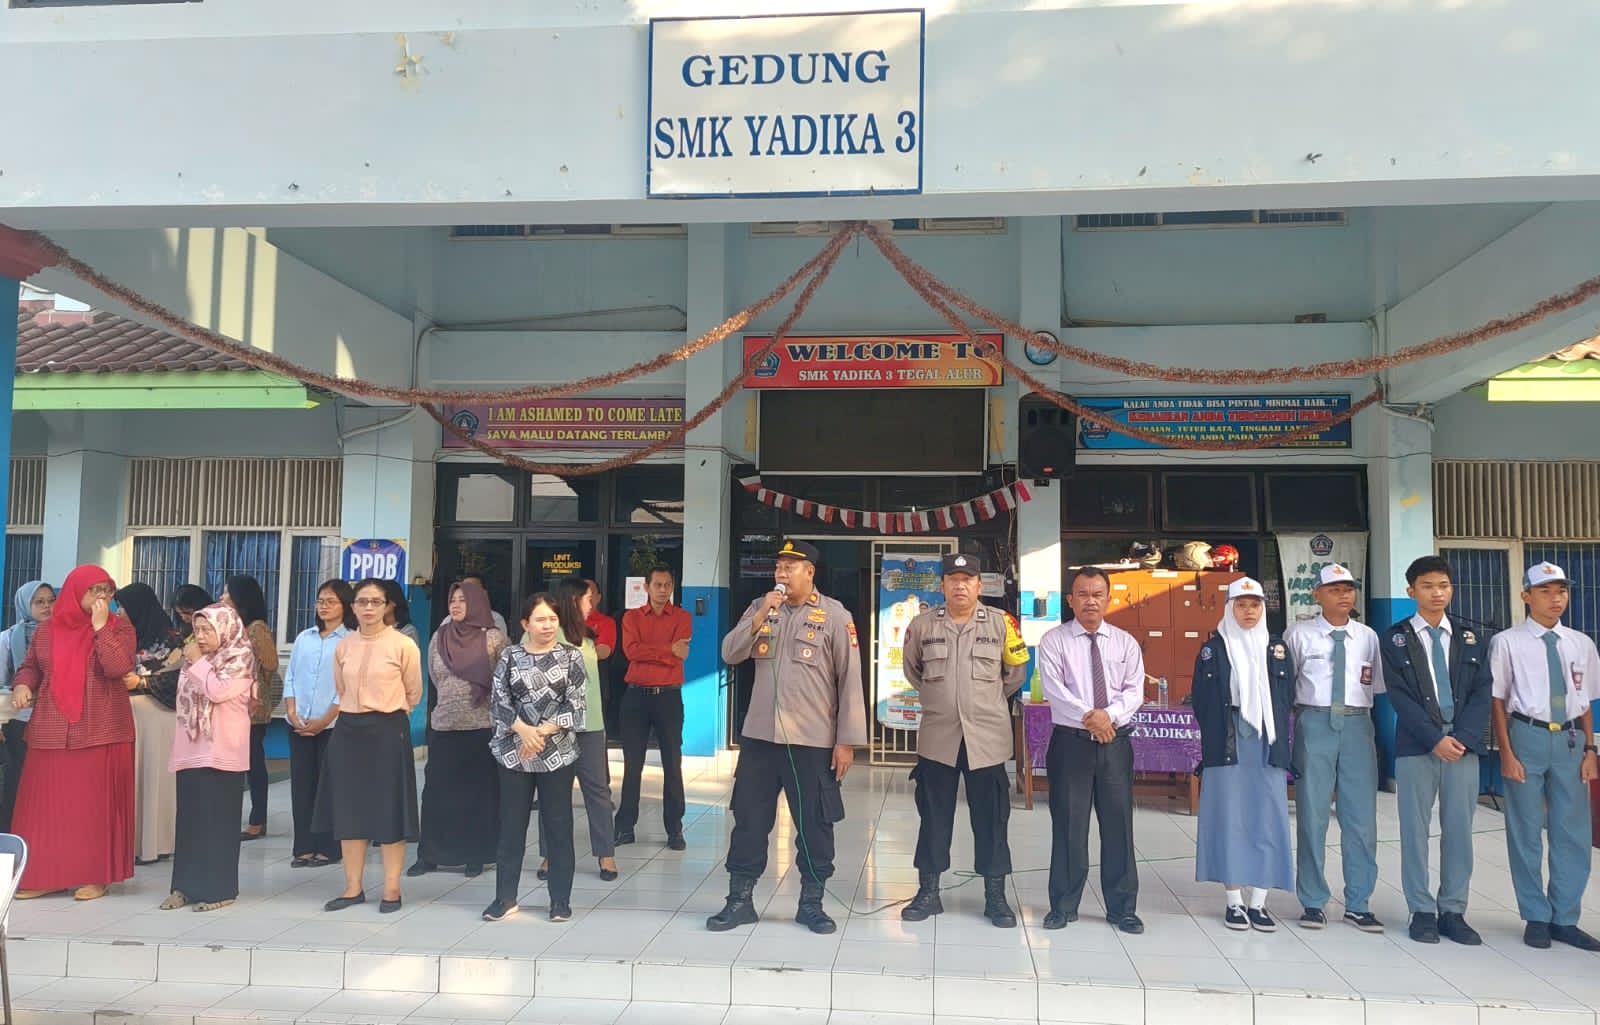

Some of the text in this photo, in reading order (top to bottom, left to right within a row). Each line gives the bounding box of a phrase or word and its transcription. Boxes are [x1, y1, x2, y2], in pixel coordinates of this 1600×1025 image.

[682, 50, 890, 87] GEDUNG
[654, 110, 916, 159] SMK YADIKA 3
[785, 342, 940, 362] WELCOME
[799, 368, 984, 381] SMK YADIKA 3 TEGAL ALUR
[1123, 400, 1150, 408] KALAU
[1152, 400, 1175, 408] ANDA
[1178, 400, 1203, 408] TIDAK
[1206, 400, 1226, 408] BISA
[1265, 399, 1301, 407] MINIMAL
[488, 407, 682, 422] I AM ASHAMED TO COME LATE
[520, 430, 554, 440] MALU
[557, 430, 608, 440] DATANG
[350, 553, 397, 580] PPDB
[542, 561, 582, 569] PRODUKSI
[803, 622, 825, 632] POLRI
[1131, 713, 1193, 725] SELAMAT
[1143, 727, 1192, 739] YADIKA
